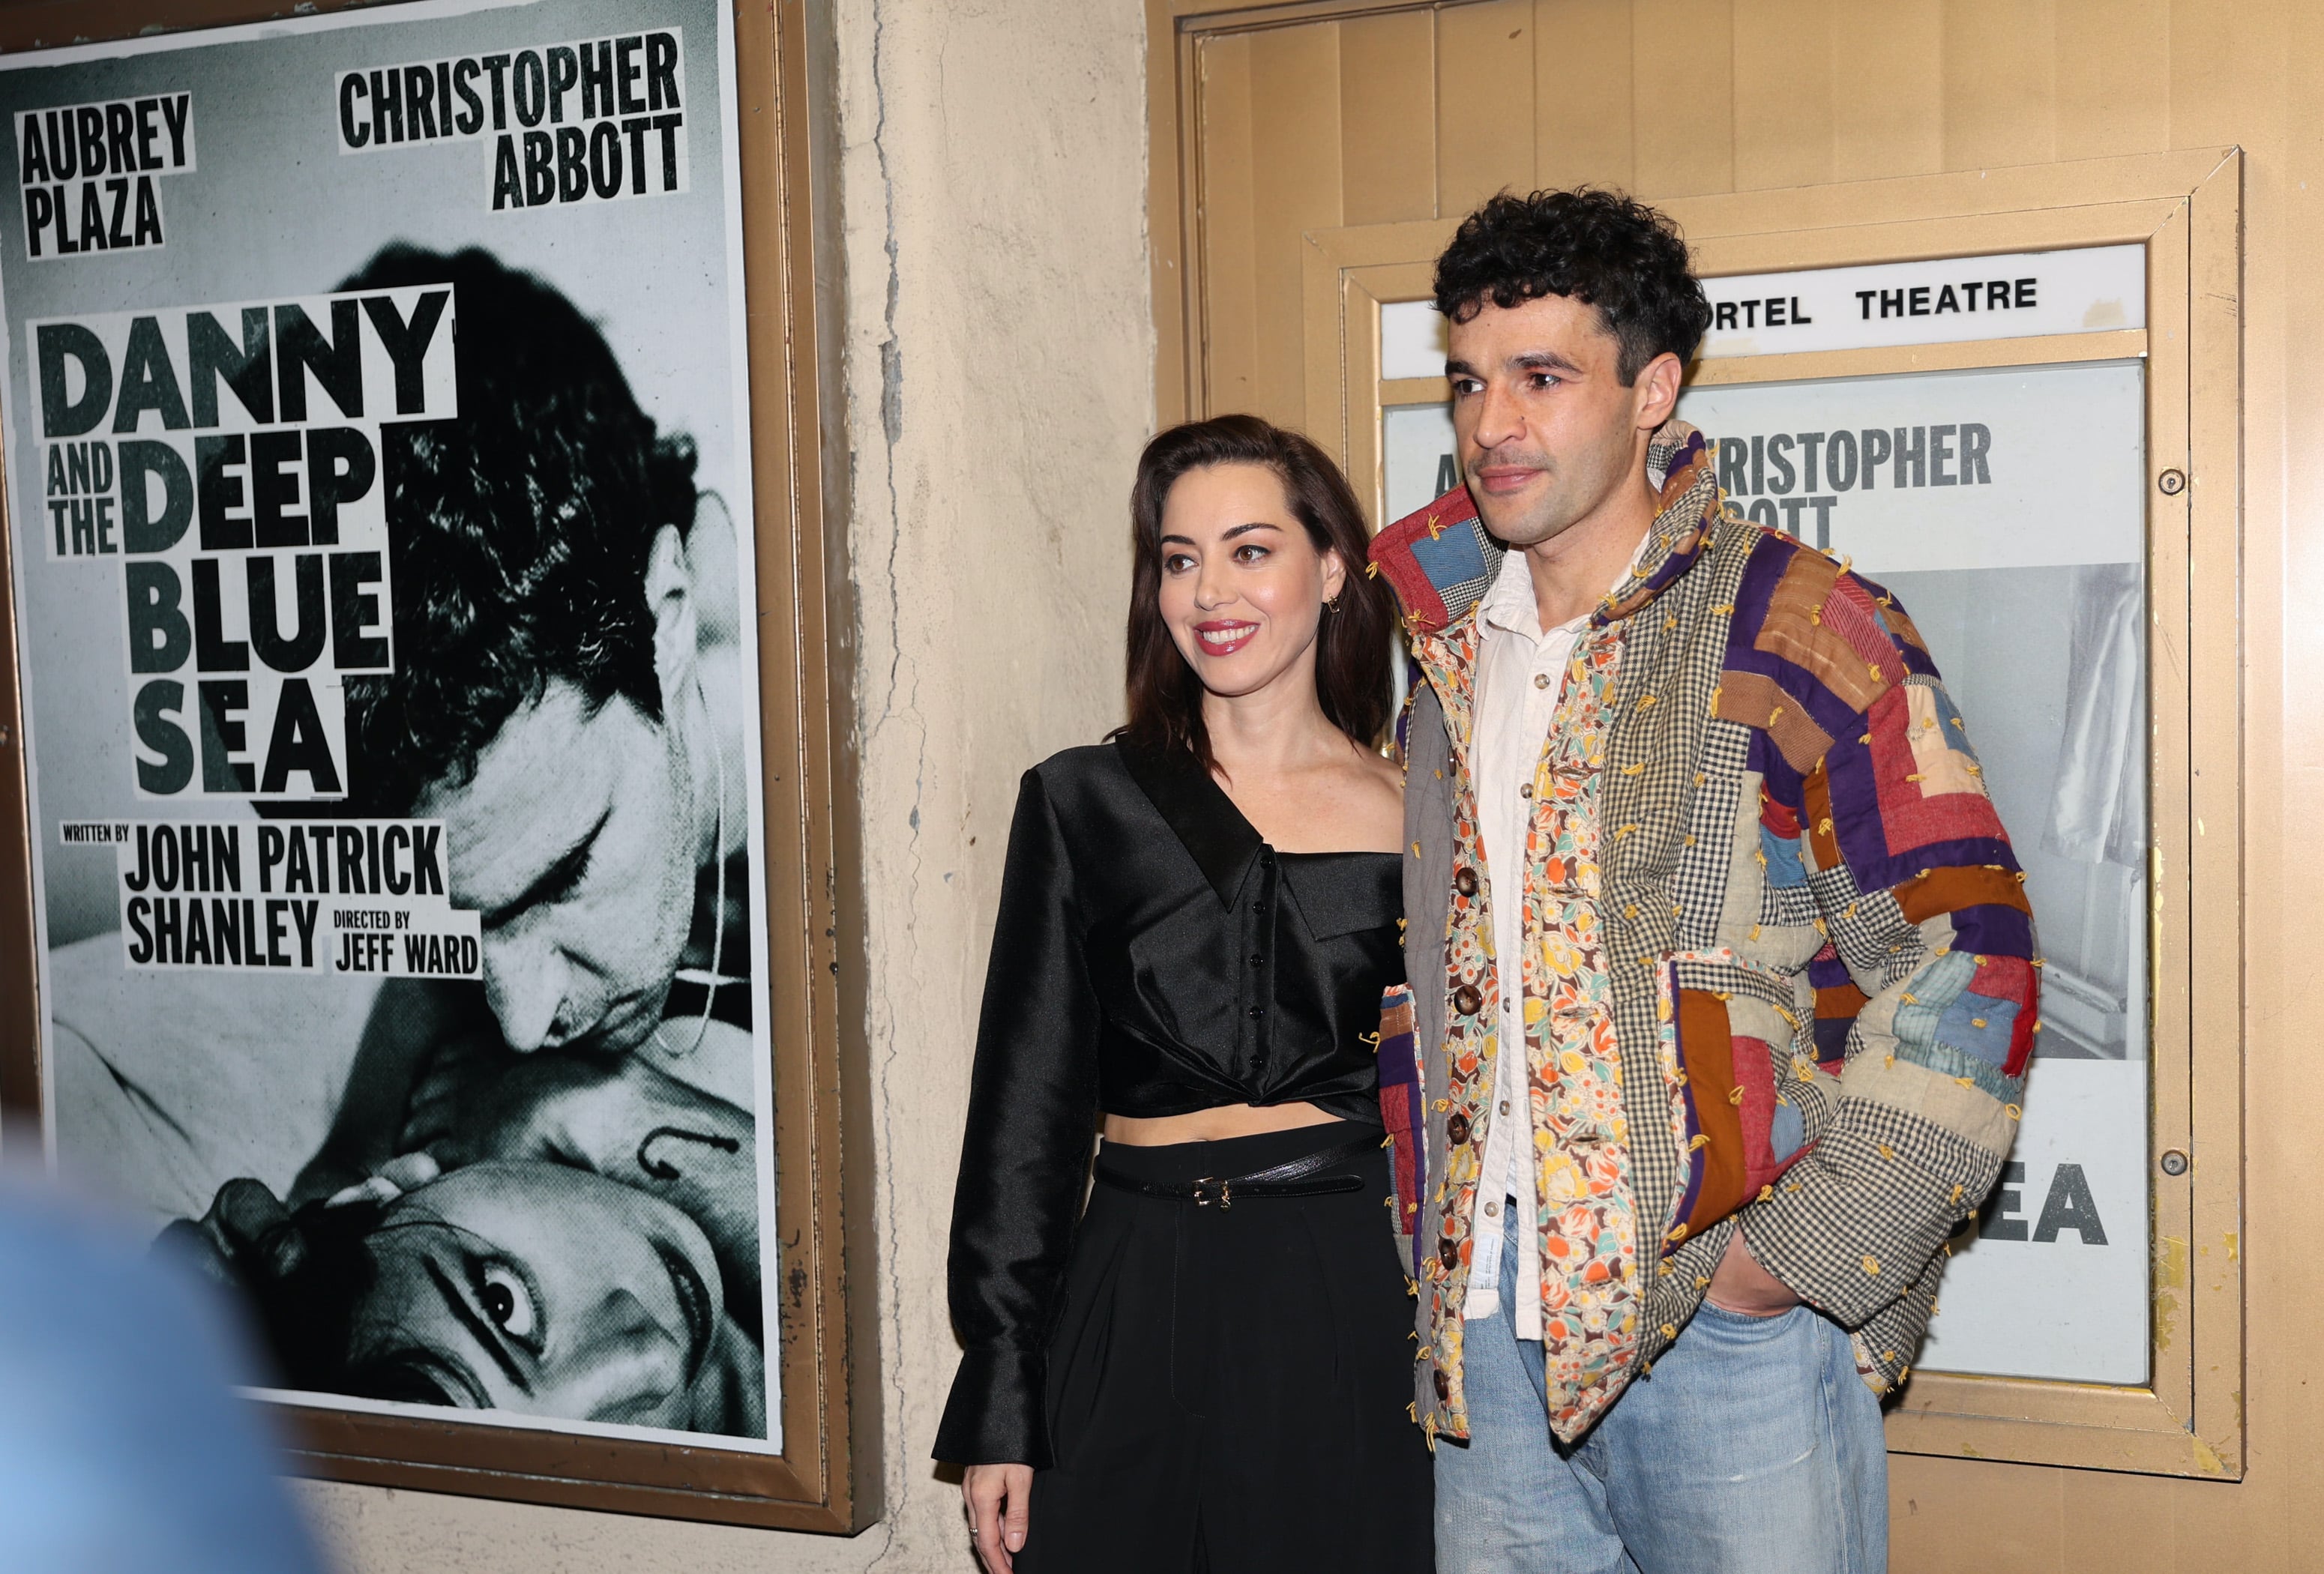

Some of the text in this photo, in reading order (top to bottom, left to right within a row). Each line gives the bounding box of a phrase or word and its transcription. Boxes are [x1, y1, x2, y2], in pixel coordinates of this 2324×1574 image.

[340, 31, 680, 148] CHRISTOPHER
[22, 94, 191, 184] AUBREY
[492, 114, 683, 211] ABBOTT
[26, 176, 163, 256] PLAZA
[1856, 278, 2037, 319] THEATRE
[37, 291, 451, 438] DANNY
[47, 441, 113, 496] AND
[118, 426, 376, 554] DEEP
[1706, 423, 1992, 497] RISTOPHER
[48, 498, 118, 556] THE
[125, 551, 390, 674] BLUE
[133, 678, 343, 795] SEA
[63, 824, 129, 842] WRITTEN BY
[124, 824, 444, 895] JOHN PATRICK
[127, 896, 319, 967] SHANLEY
[334, 910, 410, 929] DIRECTED BY
[336, 934, 478, 974] JEFF WARD
[1979, 1160, 2109, 1246] EA
